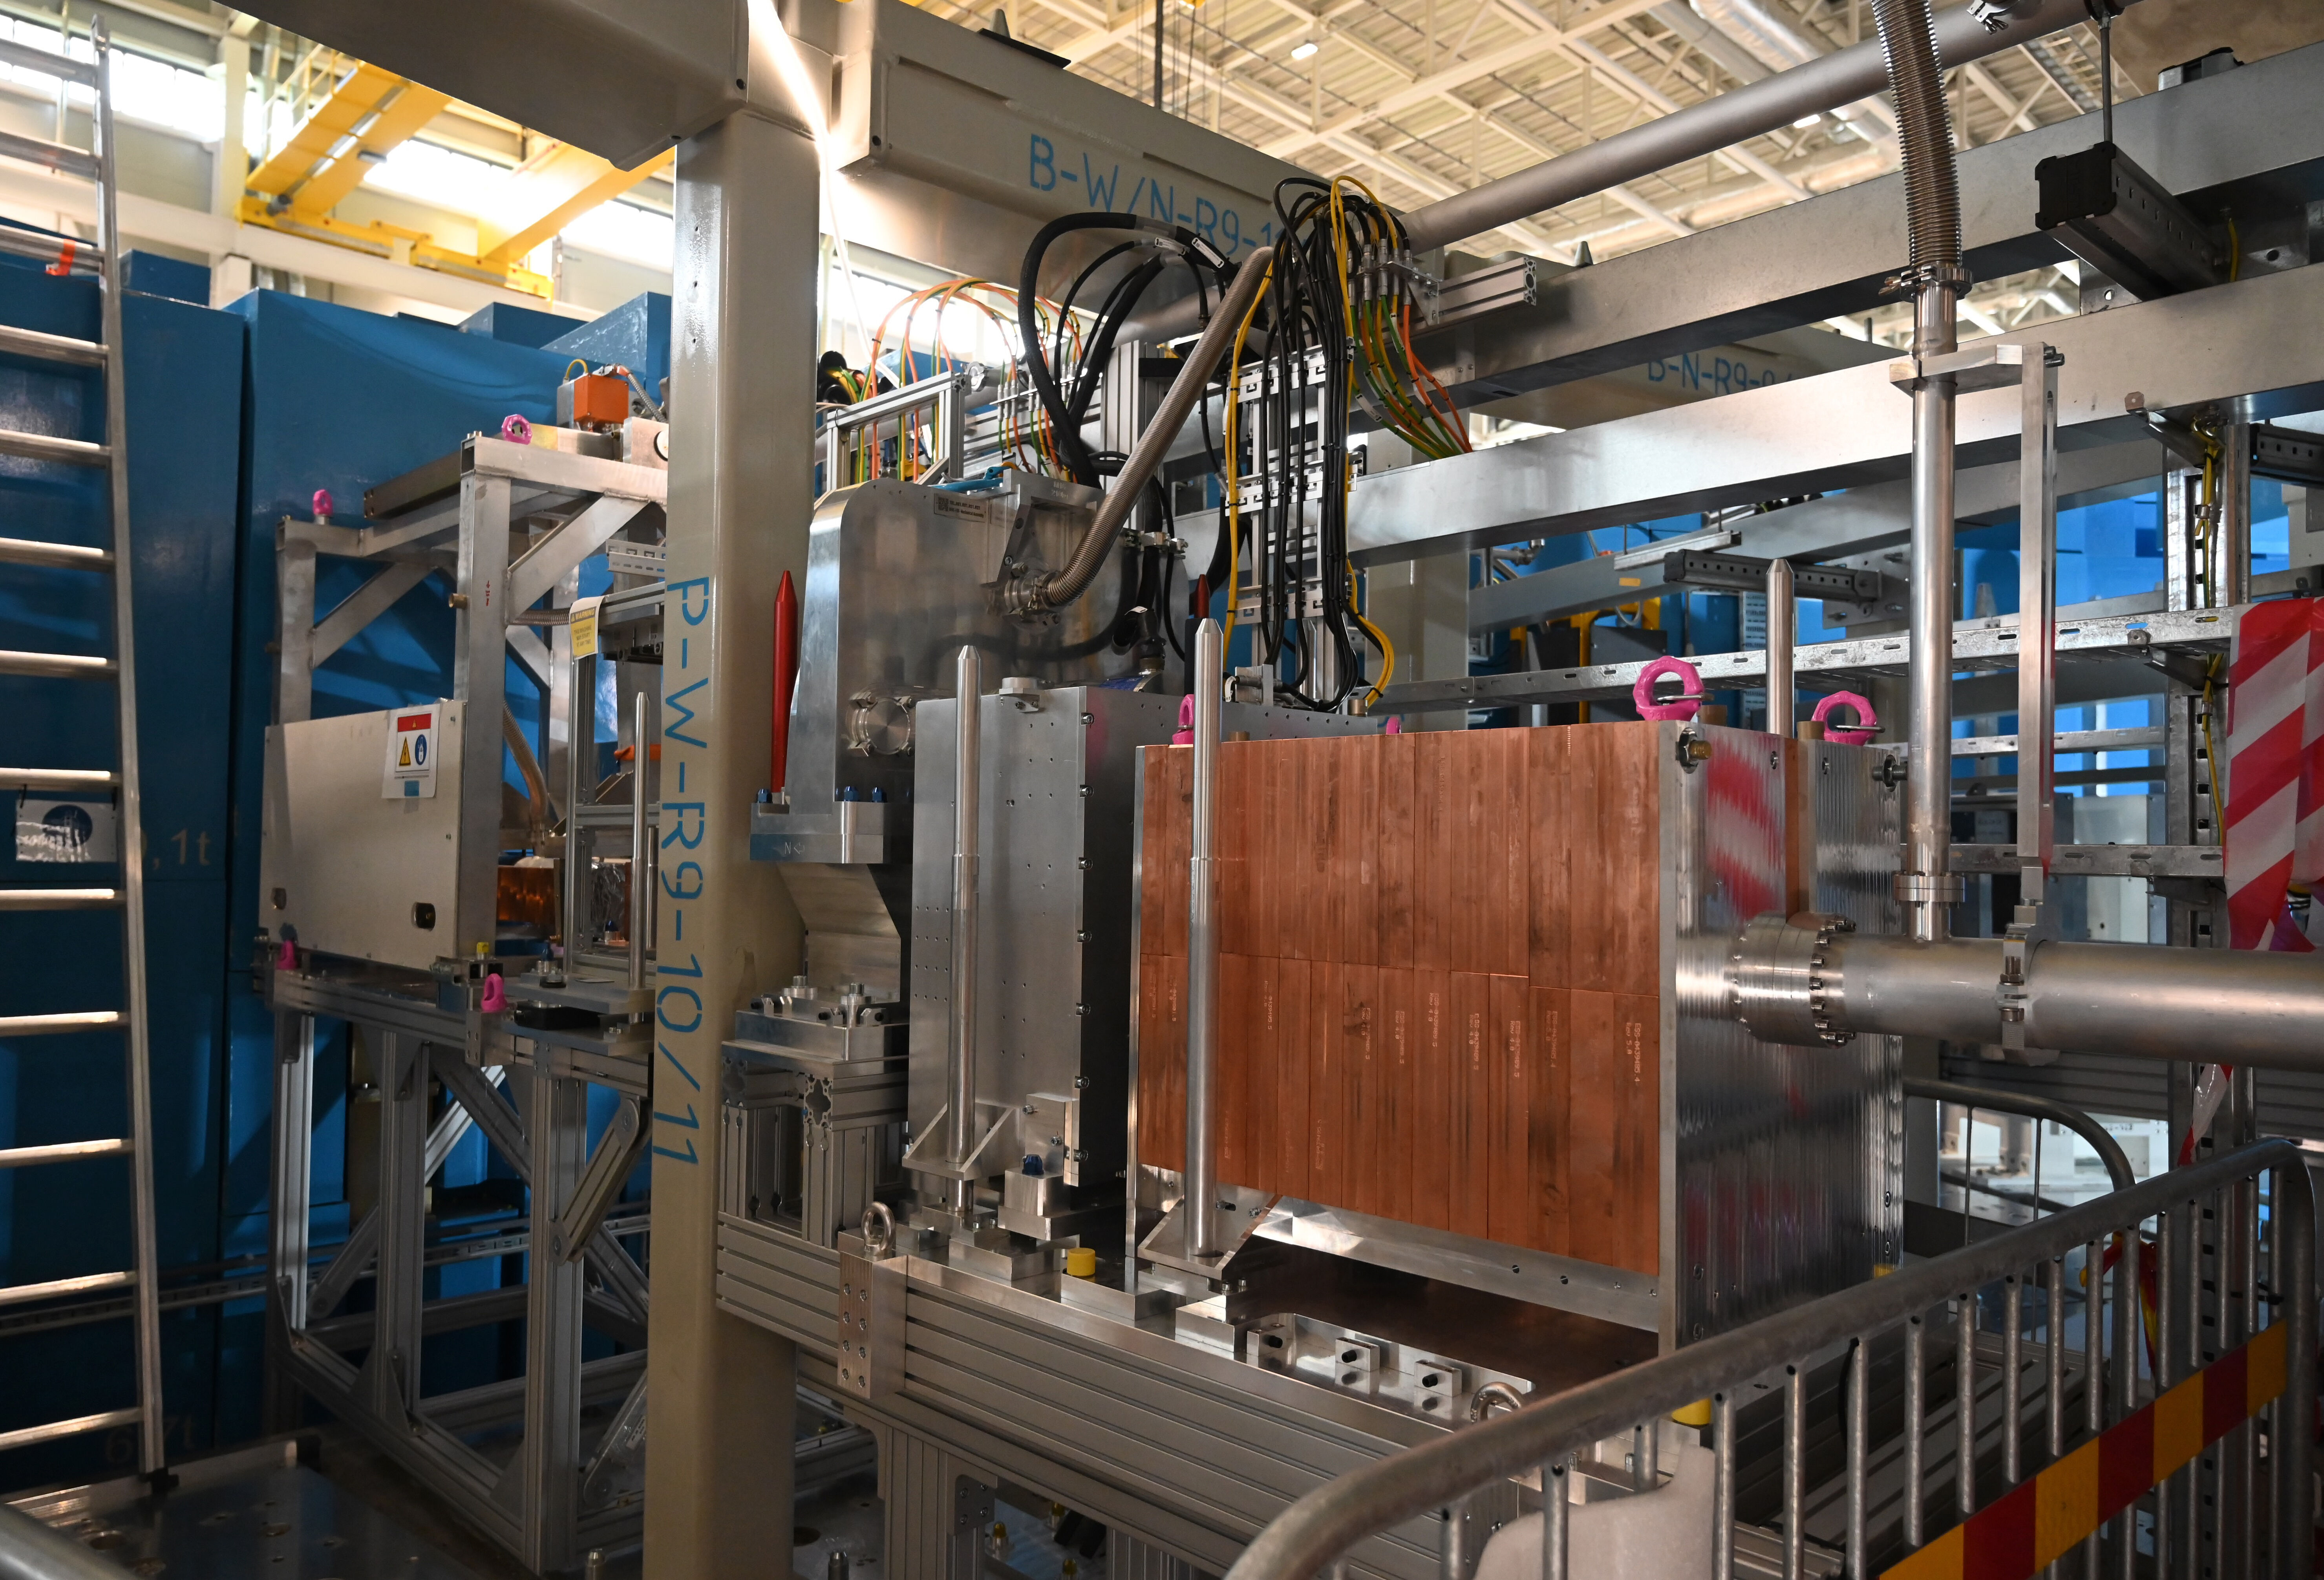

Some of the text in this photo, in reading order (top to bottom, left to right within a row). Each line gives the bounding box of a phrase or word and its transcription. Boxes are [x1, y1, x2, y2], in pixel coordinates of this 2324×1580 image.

[1649, 353, 1792, 395] B-N-R9-0
[575, 609, 595, 620] WARNING
[652, 576, 709, 1164] P-W-R9-10/11
